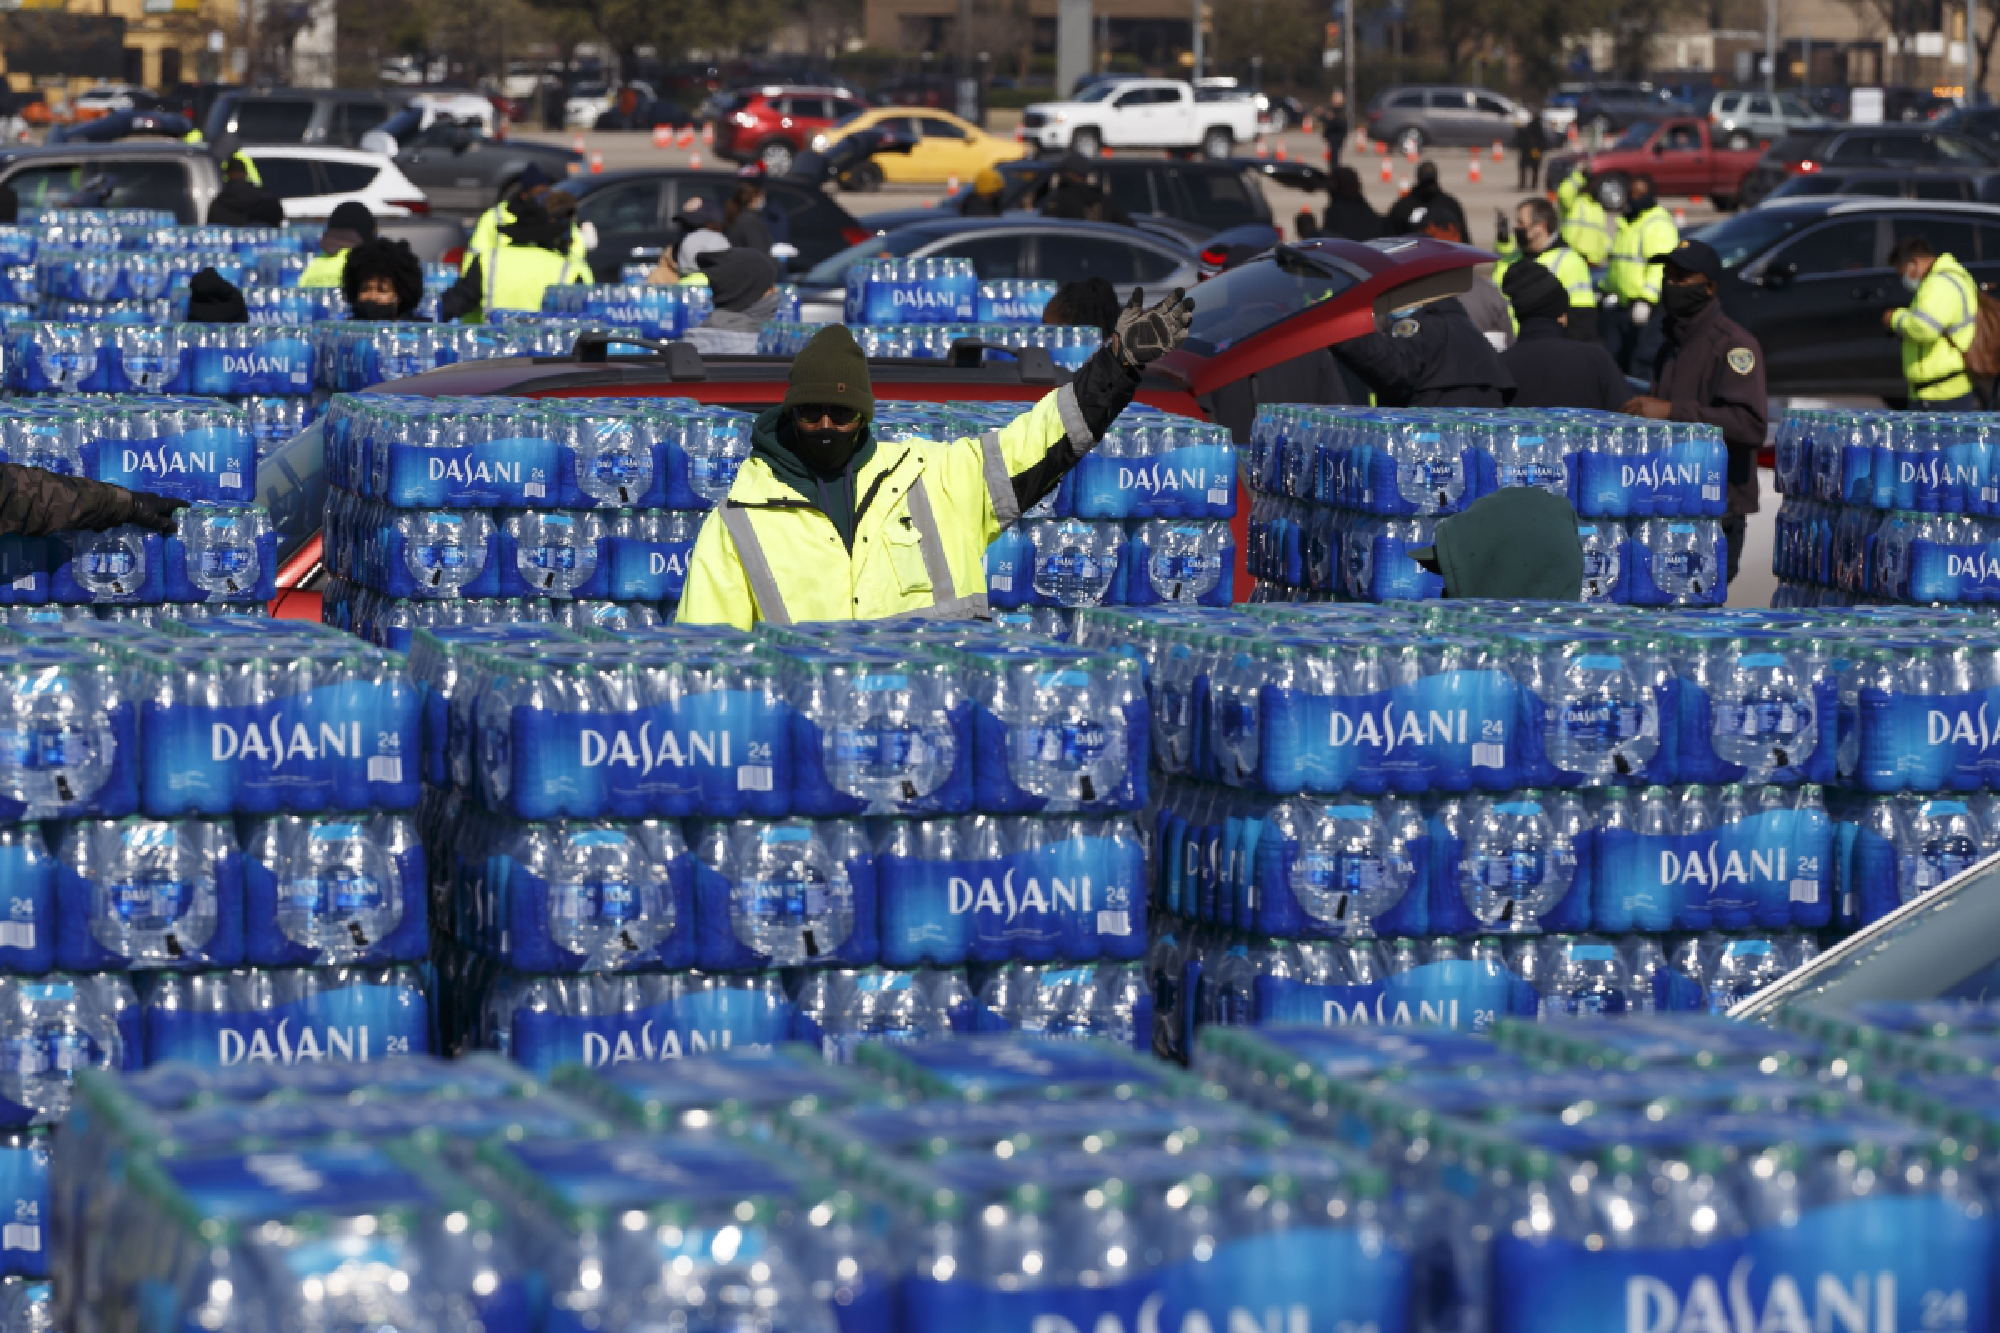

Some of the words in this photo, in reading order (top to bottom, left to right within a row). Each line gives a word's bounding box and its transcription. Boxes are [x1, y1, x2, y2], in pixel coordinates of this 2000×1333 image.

[892, 287, 954, 310] DASANI
[222, 352, 289, 377] DASANI
[122, 444, 214, 479] DASANI
[226, 457, 241, 468] 24
[429, 452, 521, 489] DASANI
[531, 467, 546, 480] 24
[1901, 457, 1978, 490] DASANI
[1119, 462, 1206, 497] DASANI
[1214, 474, 1228, 483] 24
[1621, 459, 1701, 492] DASANI
[1707, 469, 1719, 483] 24
[998, 560, 1013, 571] 24
[1948, 552, 2000, 583] DASA
[377, 730, 401, 748] 24
[1329, 702, 1468, 755] DASANI
[1481, 719, 1504, 737] 24
[1928, 701, 2000, 754] DAS
[211, 712, 361, 770] DASANI
[581, 720, 731, 777] DASANI
[747, 742, 771, 758] 24
[1659, 840, 1786, 892] DASANI
[1797, 855, 1819, 871] 24
[11, 897, 34, 915] 24
[947, 867, 1091, 923] DASANI
[1106, 885, 1129, 903] 24
[1474, 1009, 1494, 1028] 24
[219, 1017, 369, 1068] DASANI
[386, 1035, 409, 1051] 24
[14, 1199, 39, 1218] 24
[1625, 1256, 1897, 1333] DASANI
